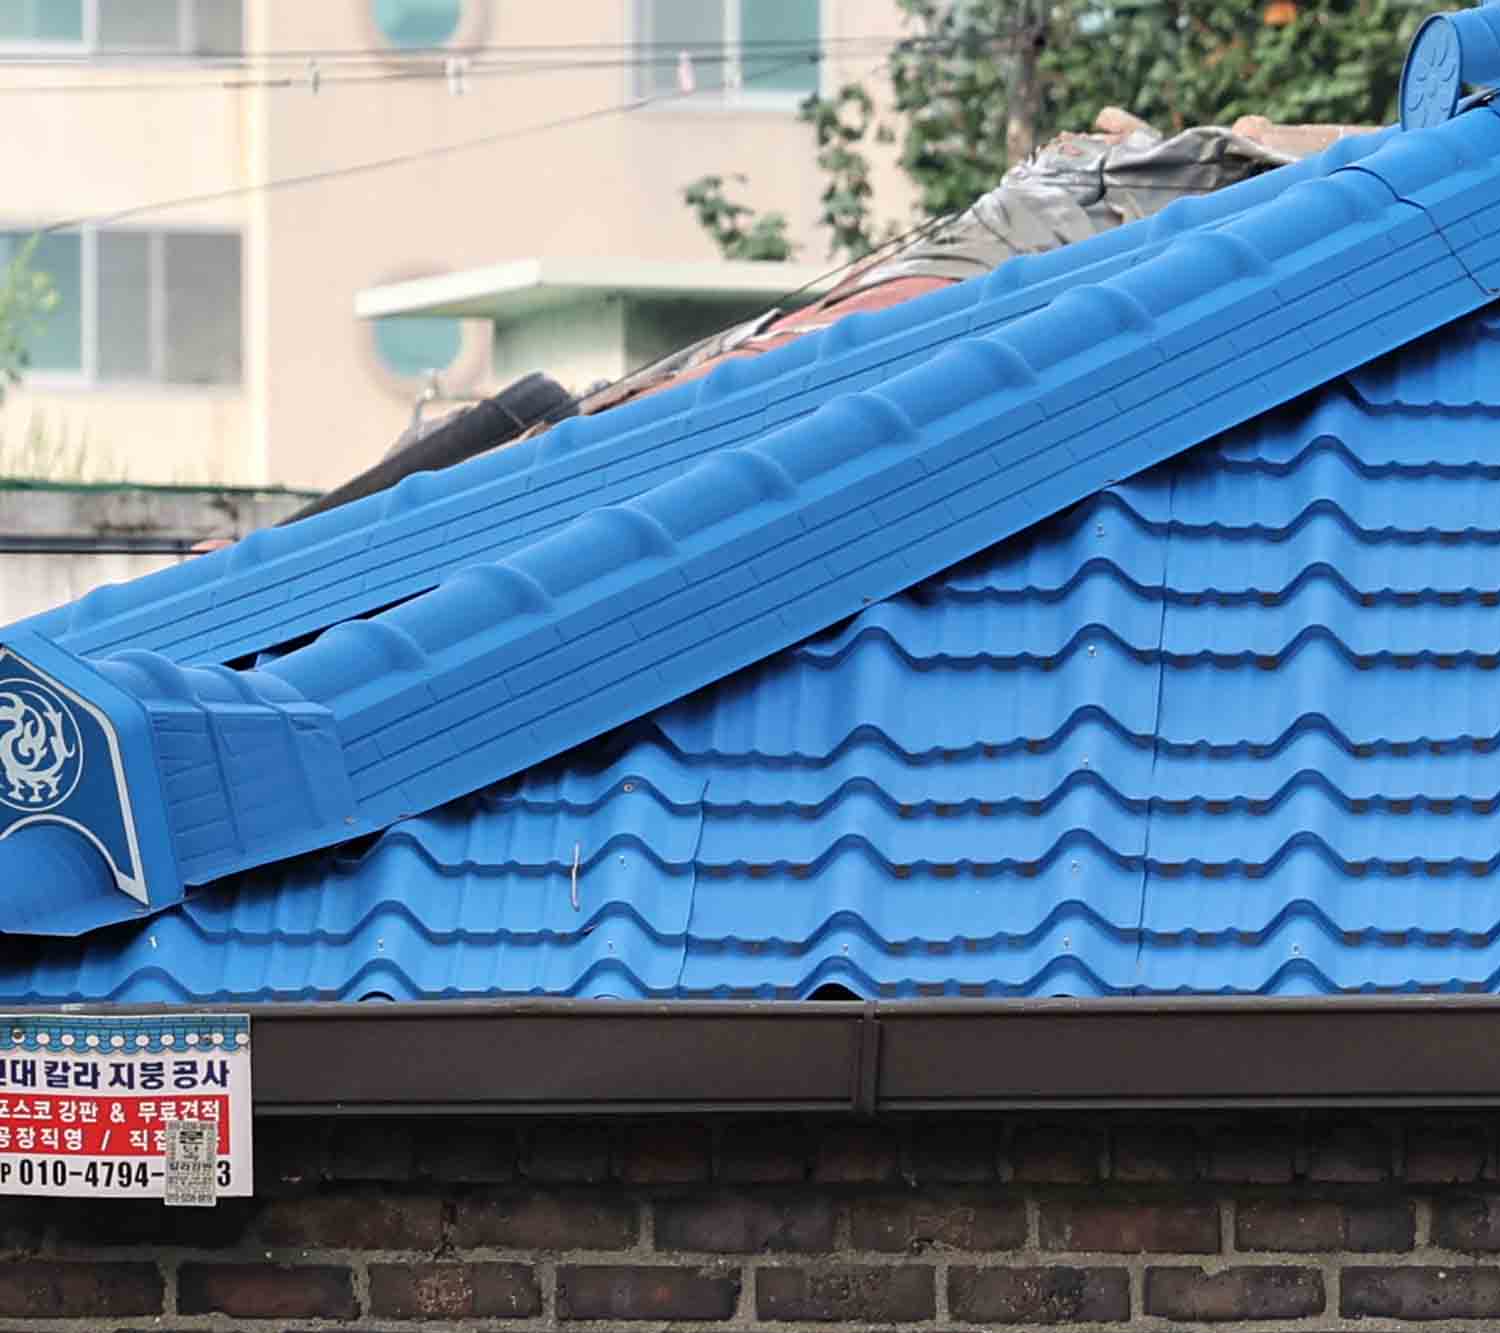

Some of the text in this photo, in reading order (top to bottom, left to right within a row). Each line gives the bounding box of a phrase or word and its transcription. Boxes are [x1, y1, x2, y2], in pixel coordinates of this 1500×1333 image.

[0, 1059, 230, 1090] 대 칼라 지붕 공사
[58, 1101, 98, 1122] 강판
[110, 1103, 126, 1122] &
[19, 1158, 231, 1188] 010-4794-3
